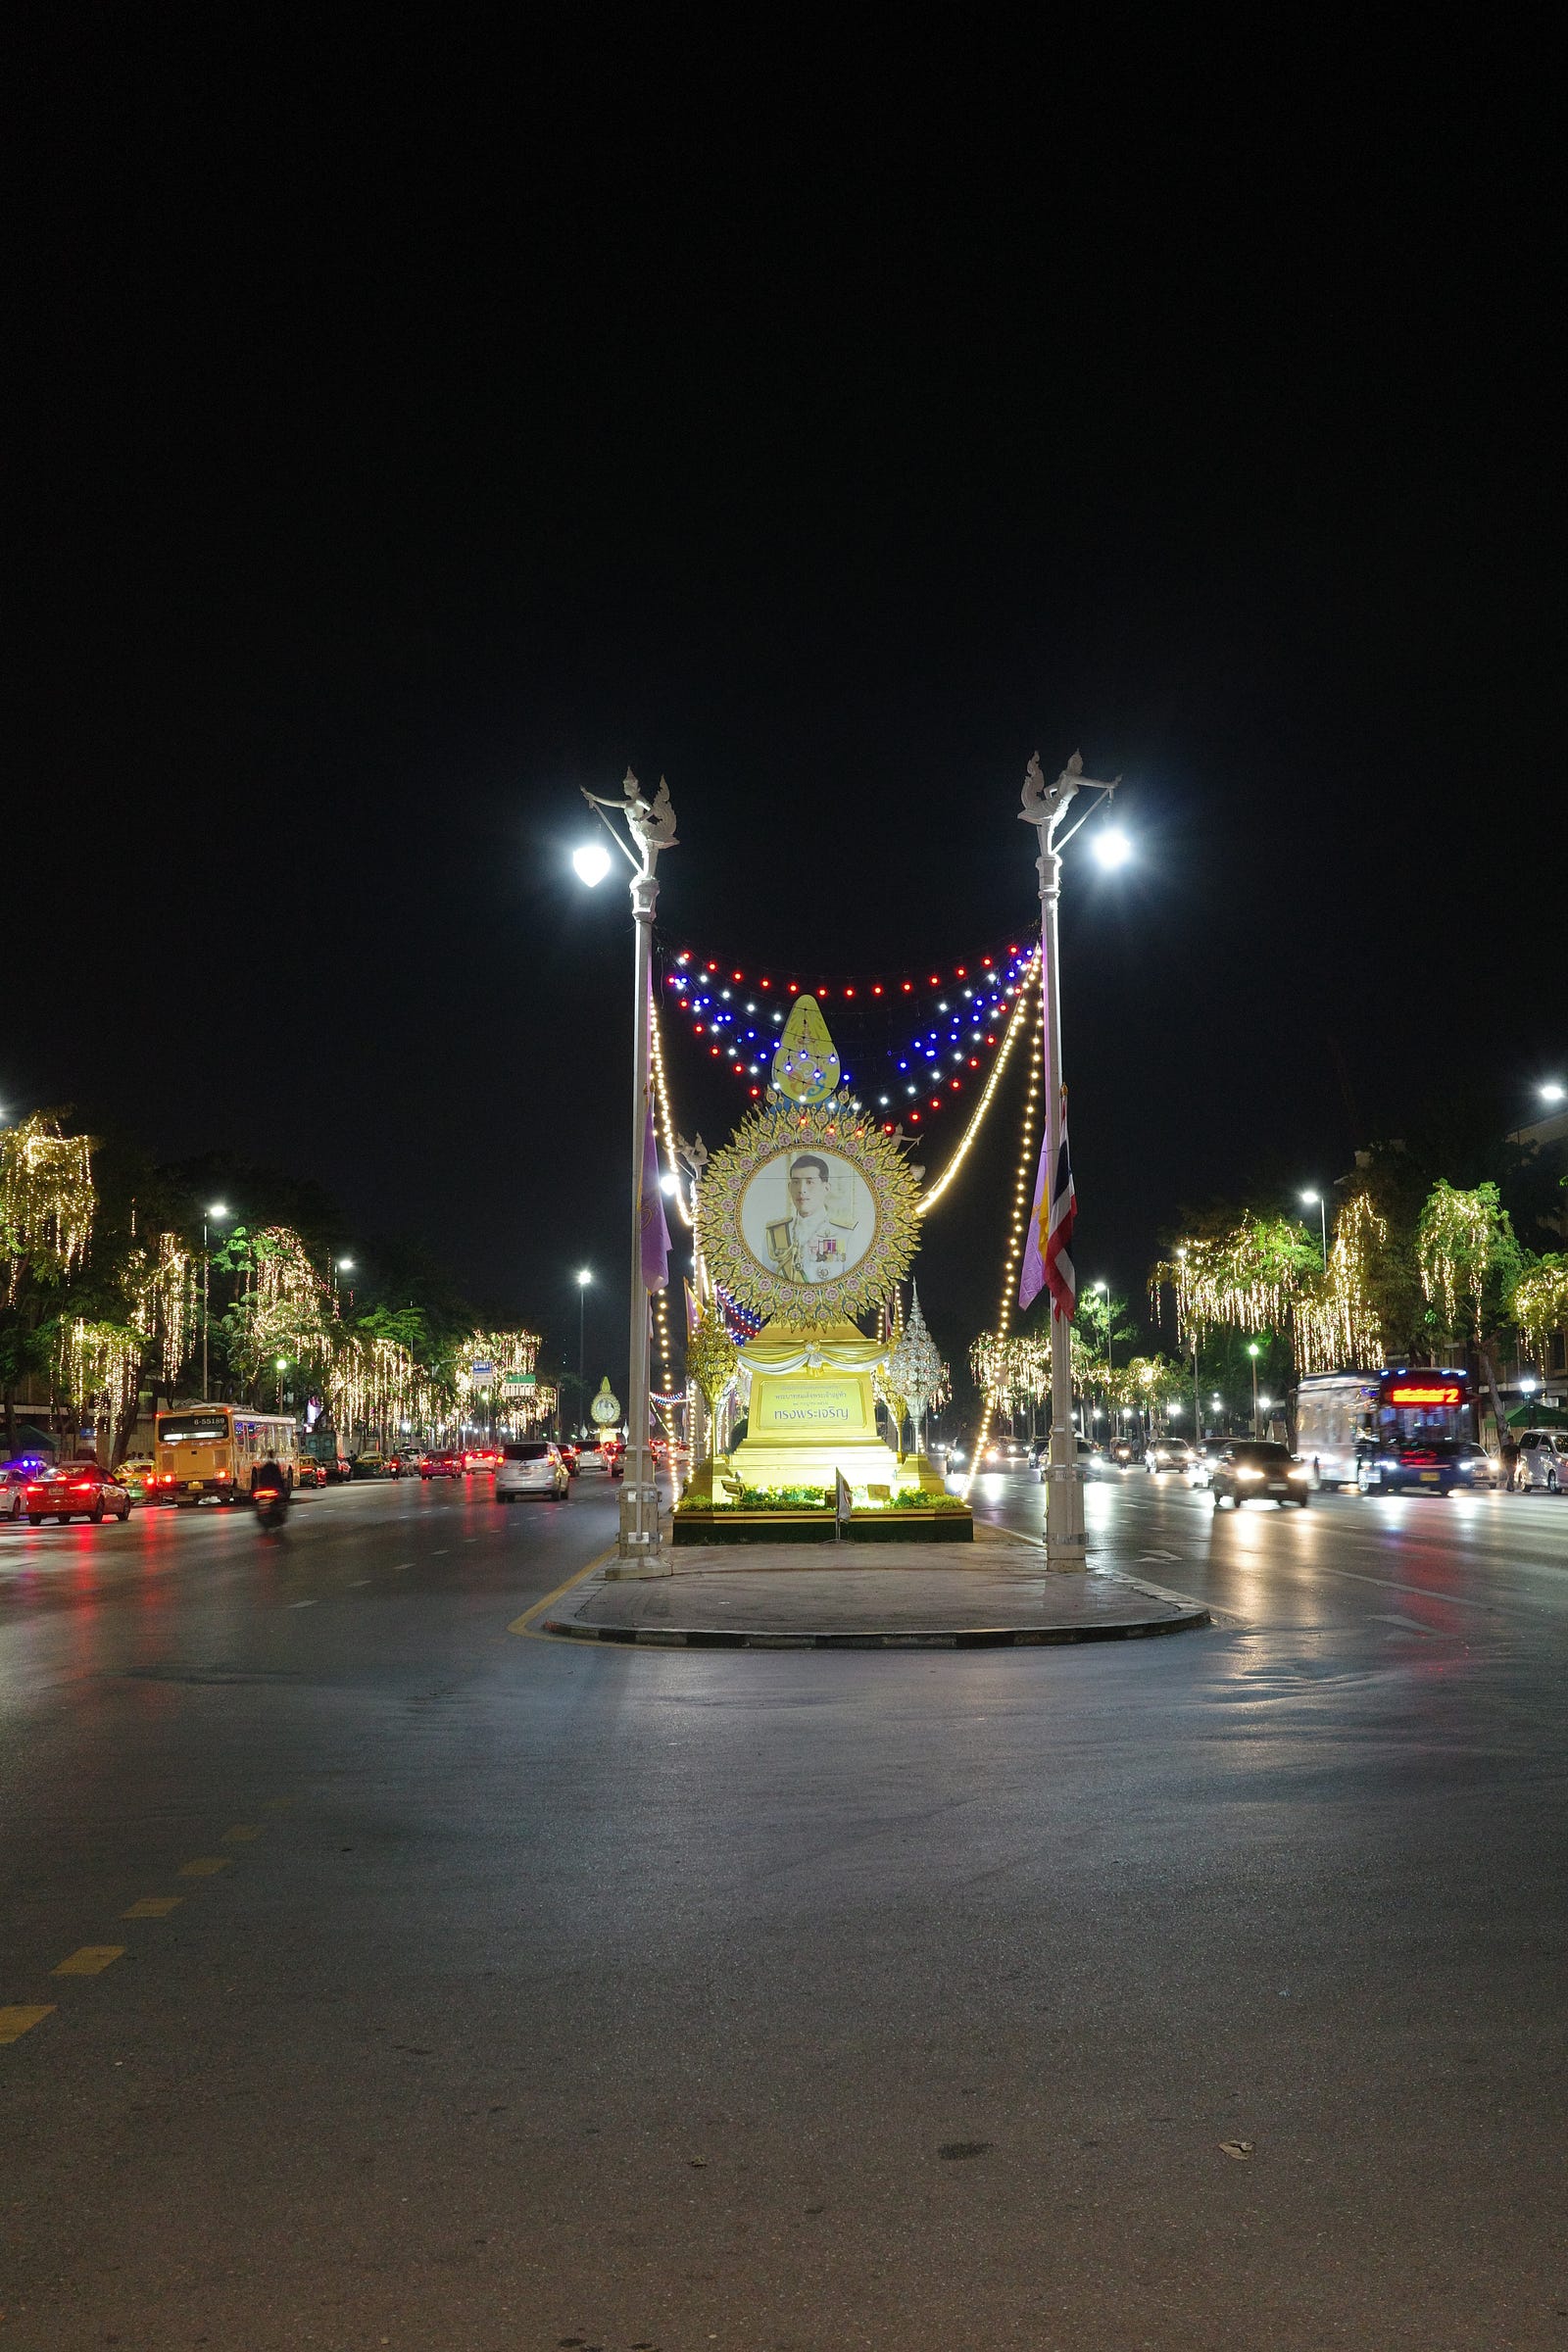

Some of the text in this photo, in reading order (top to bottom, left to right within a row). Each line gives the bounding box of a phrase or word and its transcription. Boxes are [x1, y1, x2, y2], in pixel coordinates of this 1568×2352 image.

[774, 1405, 849, 1420] ทรงพระเจริญ
